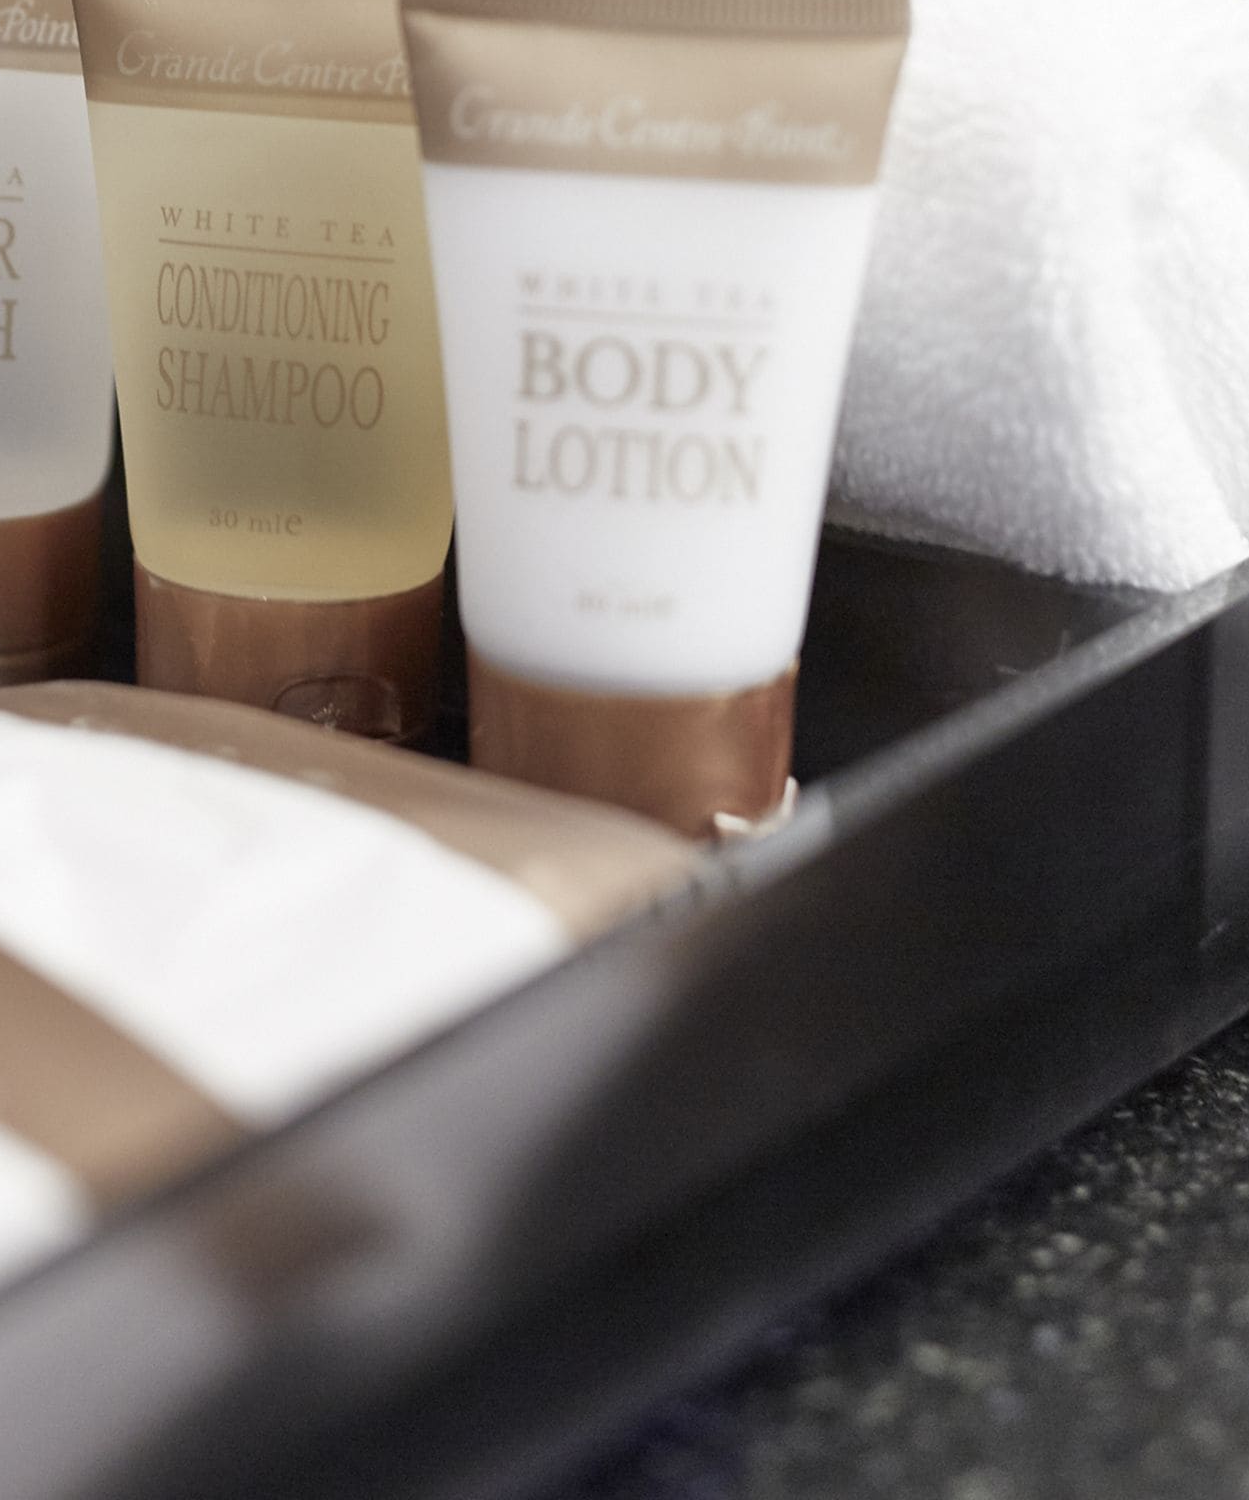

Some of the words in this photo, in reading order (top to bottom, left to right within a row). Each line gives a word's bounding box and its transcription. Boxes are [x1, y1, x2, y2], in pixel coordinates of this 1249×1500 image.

[115, 29, 249, 84] Grande
[253, 40, 370, 92] Centre
[160, 205, 291, 238] WHITE
[319, 220, 396, 247] TEA
[157, 261, 391, 346] CONDITIONING
[156, 346, 385, 431] SHAMPOO
[516, 328, 771, 418] BODY
[511, 417, 768, 504] LOTION
[208, 507, 239, 530] 30
